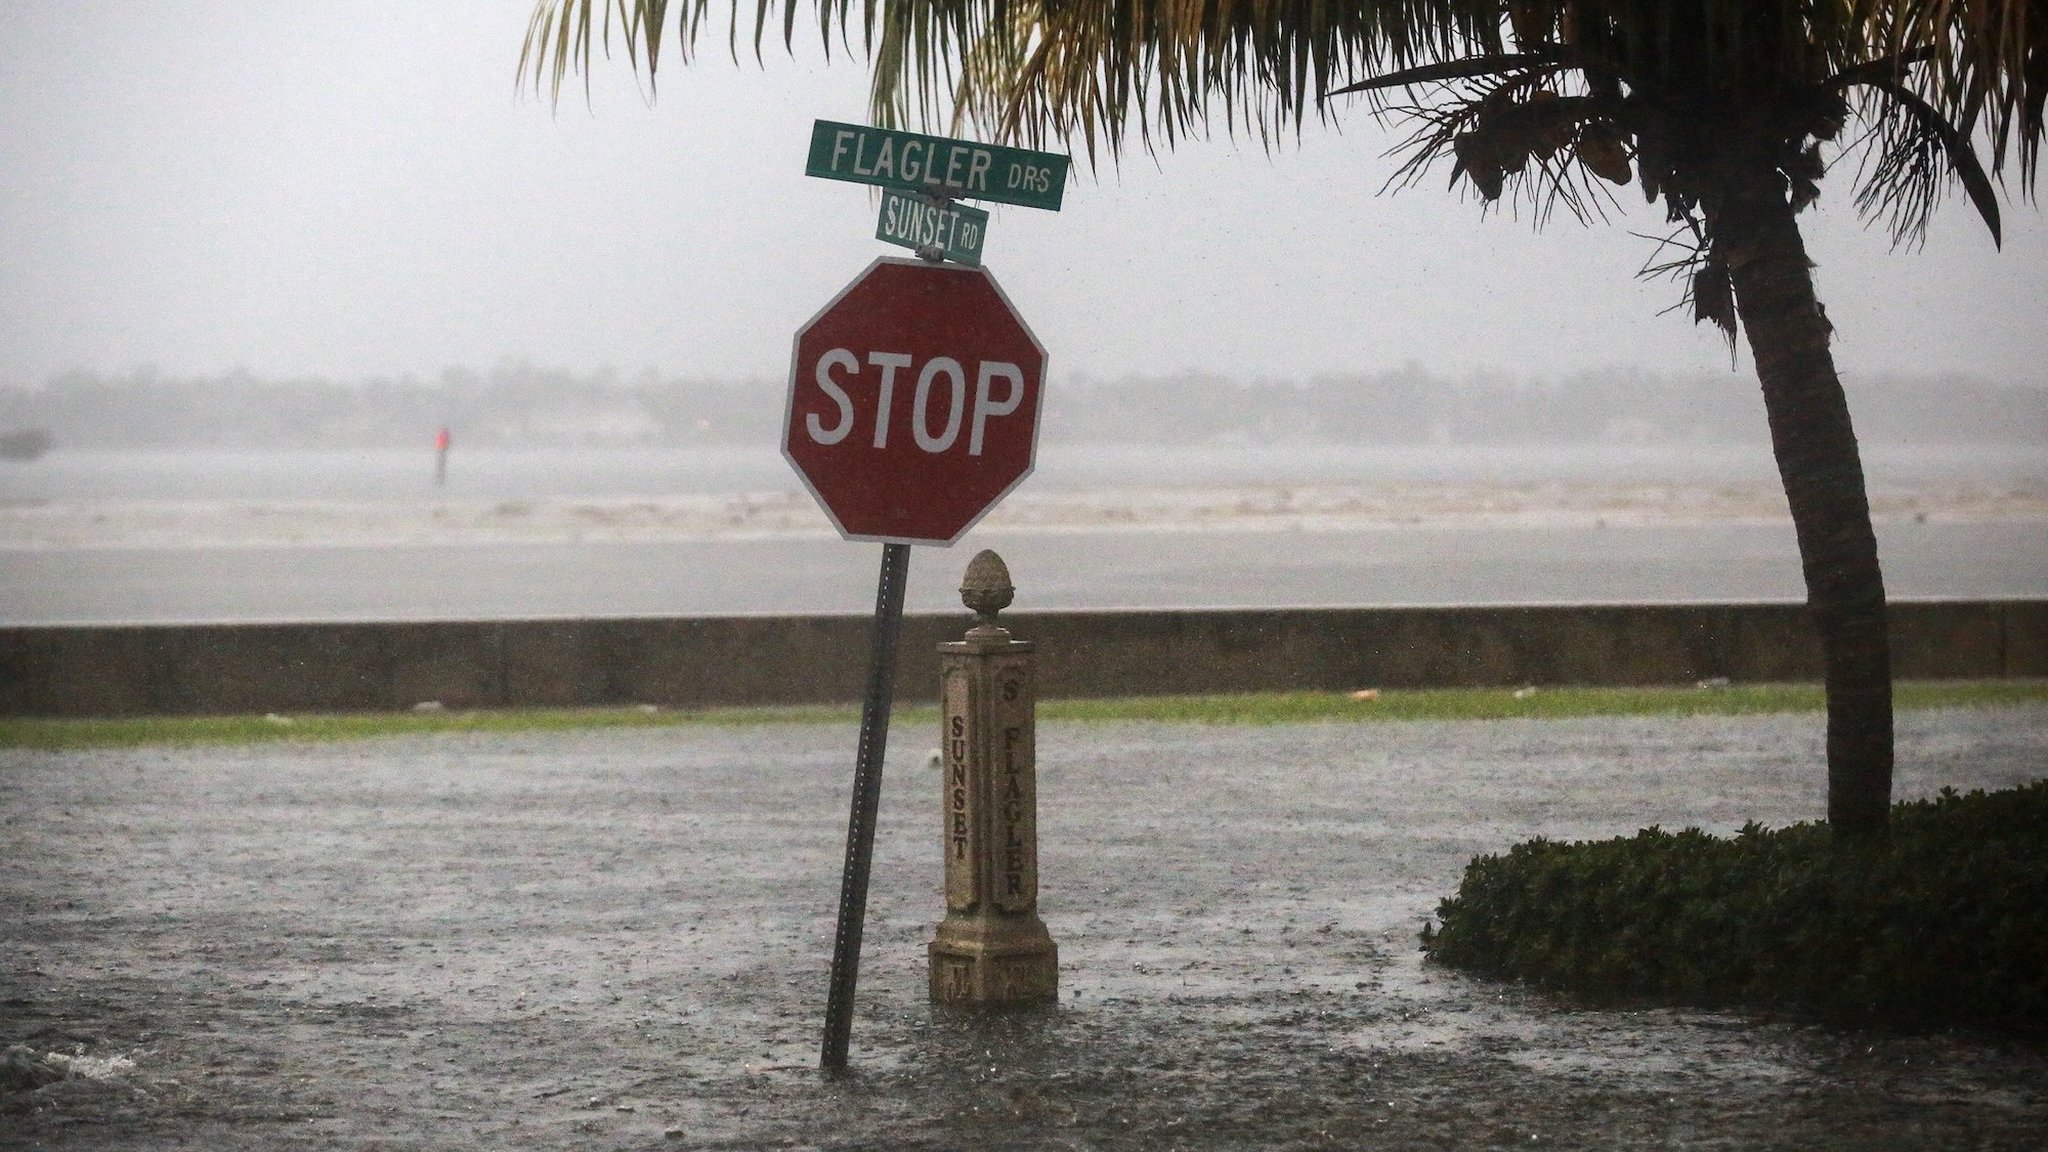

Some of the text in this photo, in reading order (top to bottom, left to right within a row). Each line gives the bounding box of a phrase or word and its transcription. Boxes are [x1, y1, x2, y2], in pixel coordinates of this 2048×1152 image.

[830, 130, 992, 192] FLAGLER
[885, 195, 979, 251] SUNSET RD
[806, 348, 1025, 456] STOP
[950, 715, 968, 860] SUNSET
[1003, 727, 1022, 896] FLAGLER
